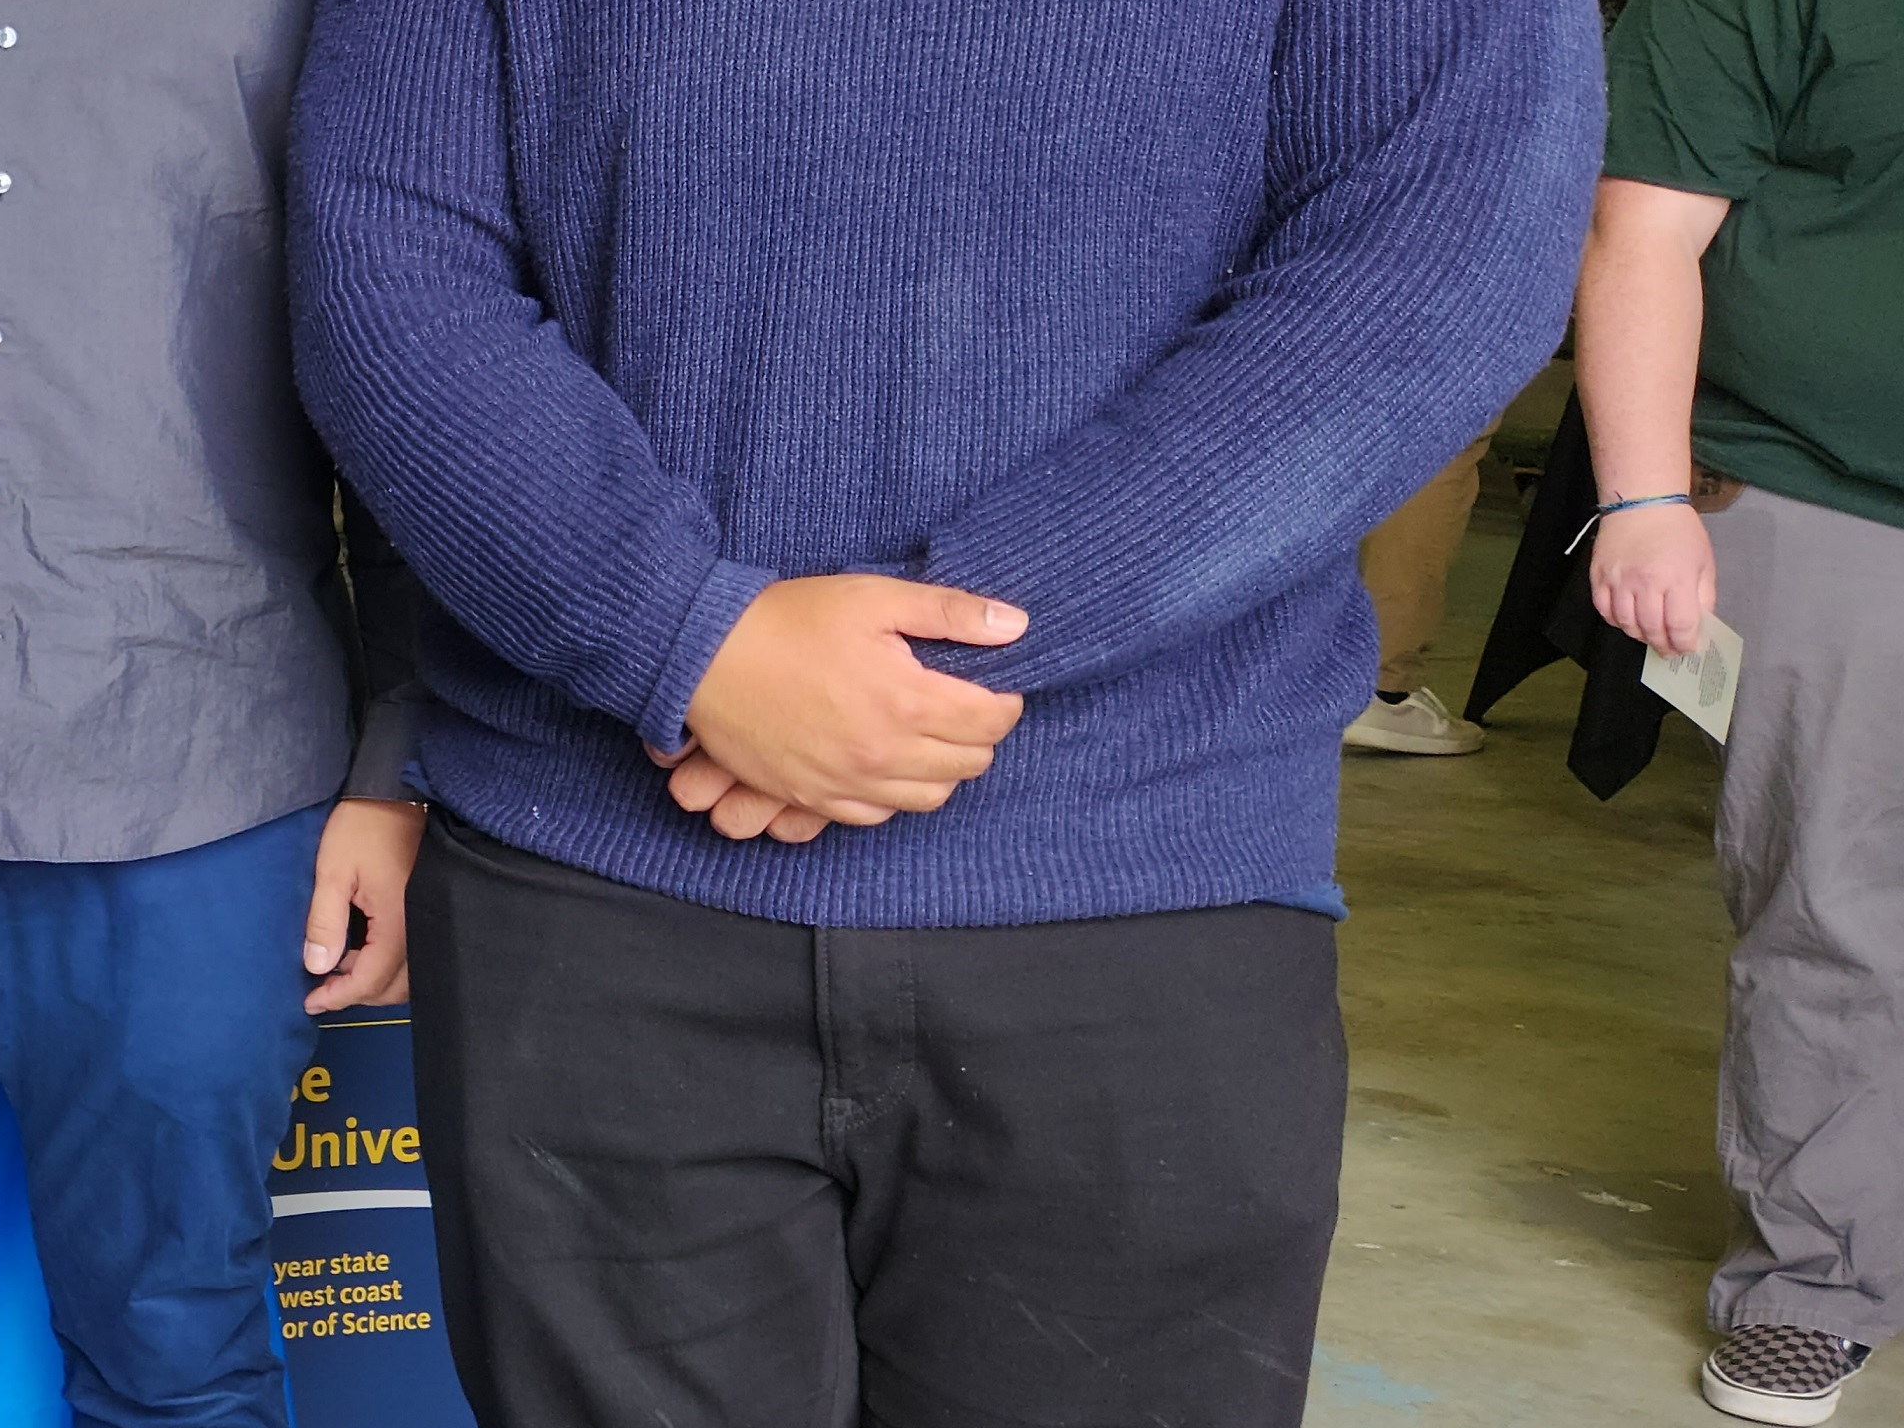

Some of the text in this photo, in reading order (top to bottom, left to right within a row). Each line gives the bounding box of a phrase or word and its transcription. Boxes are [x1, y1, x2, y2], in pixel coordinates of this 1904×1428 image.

[291, 1066, 331, 1103] e
[272, 1116, 422, 1171] Unive
[273, 1251, 390, 1285] year state
[279, 1280, 403, 1308] west coast
[279, 1310, 431, 1339] or of Science
